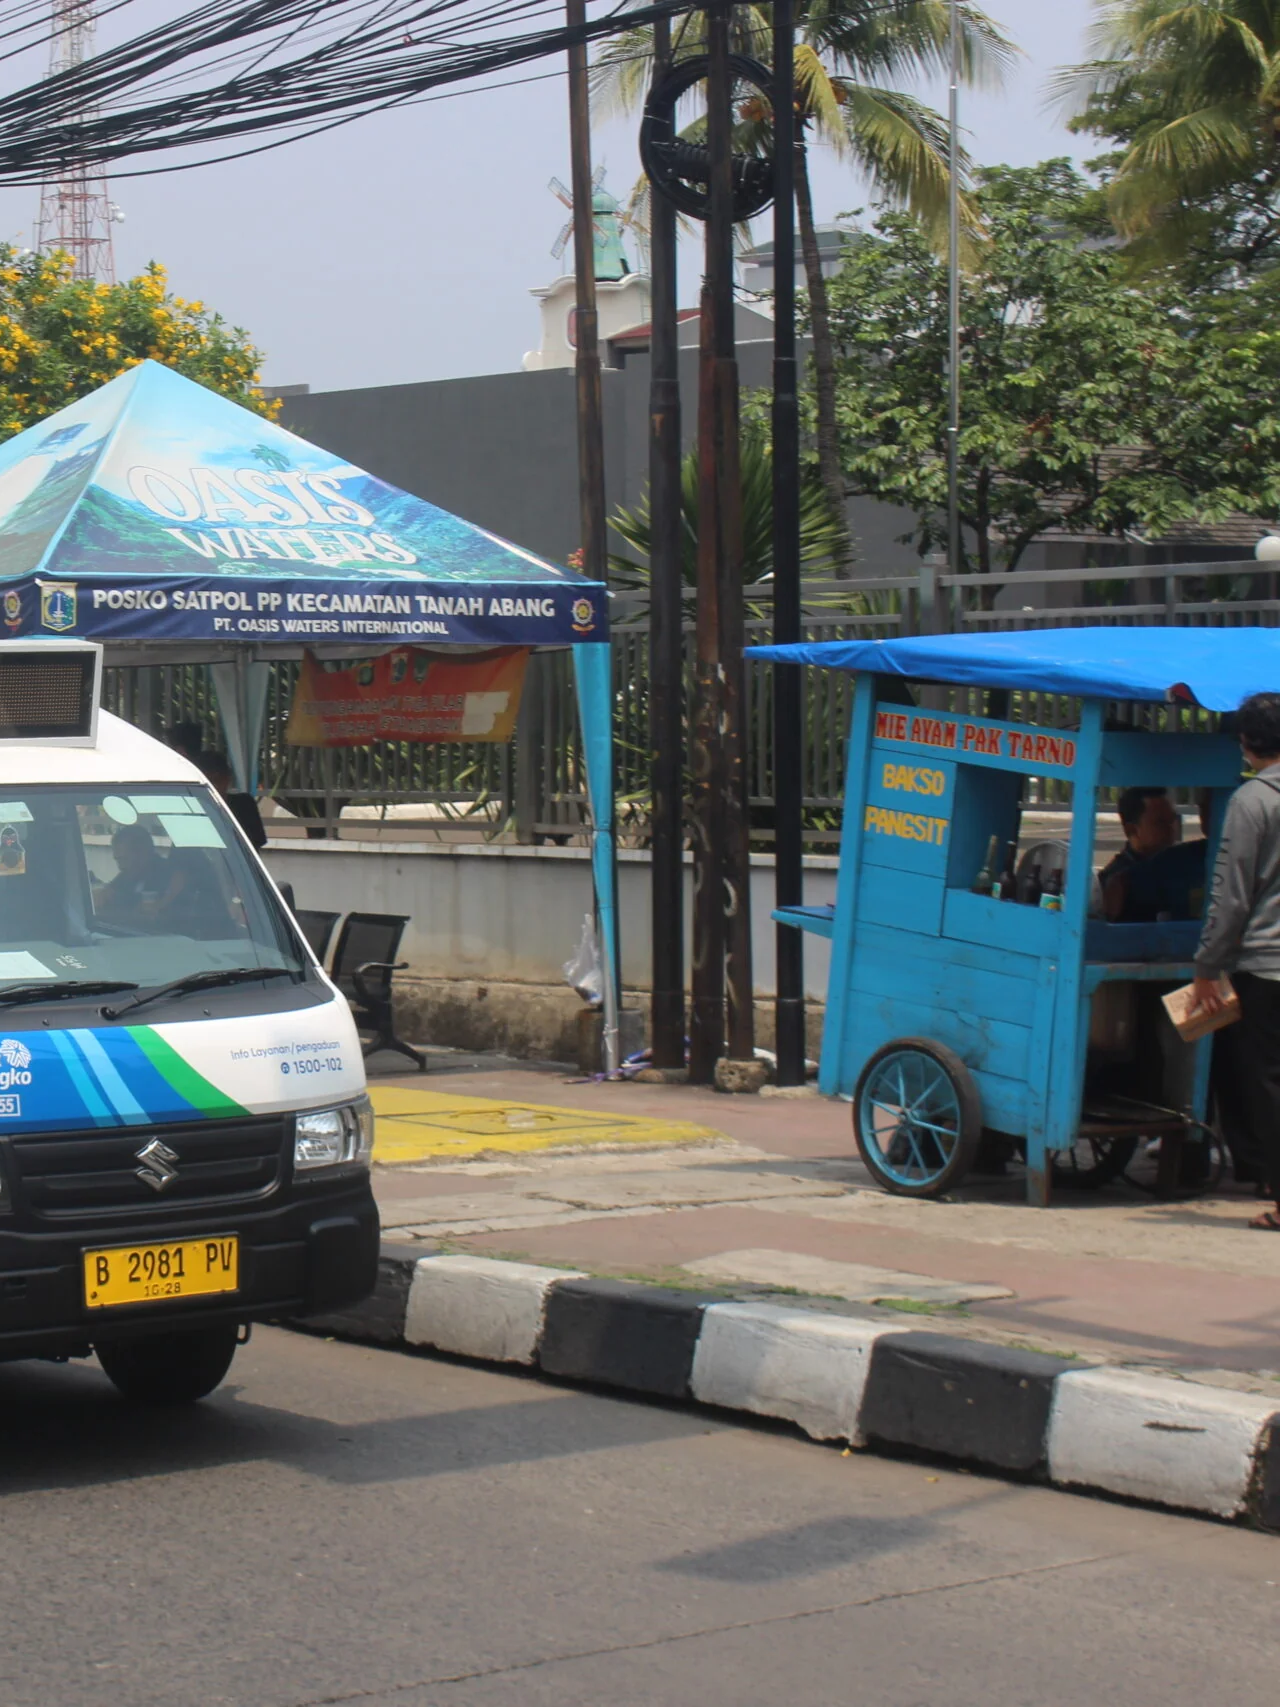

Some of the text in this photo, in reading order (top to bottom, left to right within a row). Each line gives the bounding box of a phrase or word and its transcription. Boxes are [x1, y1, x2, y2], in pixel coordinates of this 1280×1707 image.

[127, 466, 375, 527] OASIS
[161, 528, 418, 566] WATERS
[92, 590, 556, 617] POSKO SATPOL PP KECAMATAN TANAH ABANG
[214, 617, 449, 635] PT. OASIS WATERS INTERNATIONAL
[875, 712, 1076, 768] MIE AYAM PAK TARNO
[882, 763, 946, 797] BAKSO
[864, 805, 949, 846] PANGSIT
[230, 1049, 249, 1061] Info
[293, 1057, 343, 1074] 1500-102
[95, 1241, 233, 1287] B 2981 PV
